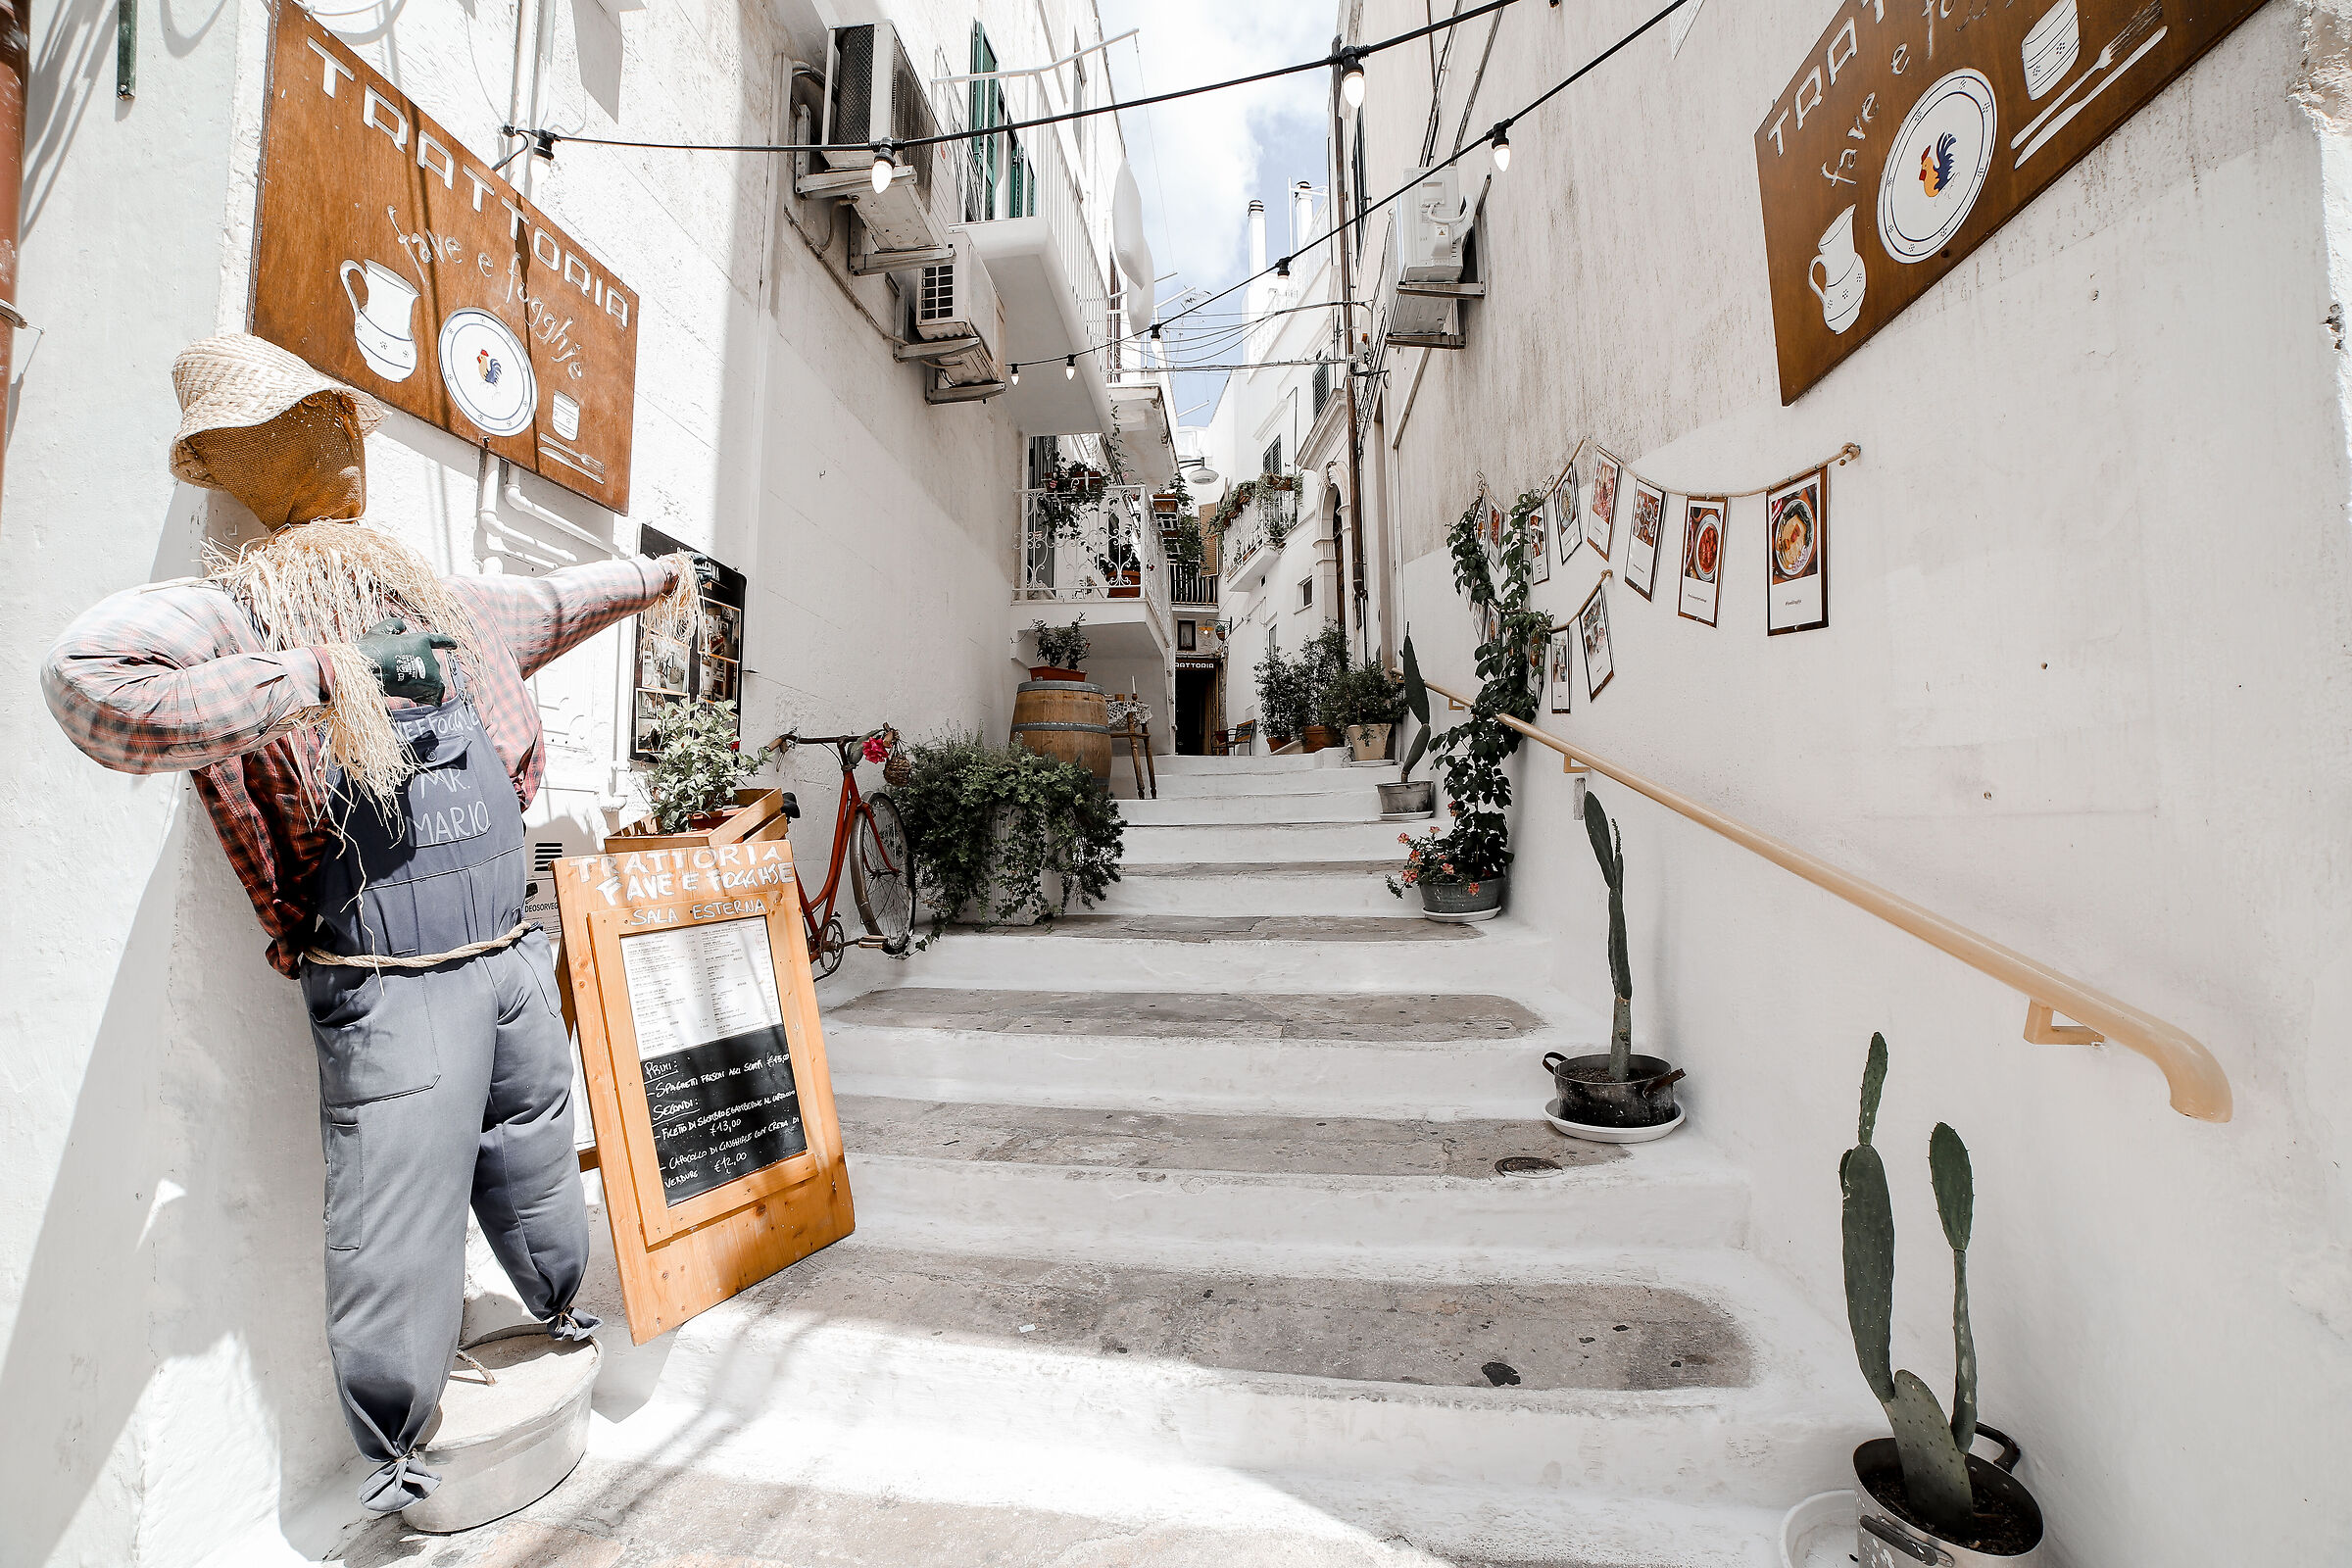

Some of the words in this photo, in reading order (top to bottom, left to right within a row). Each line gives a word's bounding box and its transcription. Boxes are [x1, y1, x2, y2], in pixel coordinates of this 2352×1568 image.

[1821, 92, 1880, 187] fave
[1890, 43, 1911, 75] e
[307, 36, 628, 328] TRATTORIA
[387, 205, 463, 284] fave
[477, 252, 494, 278] e
[406, 801, 489, 847] MARIO
[569, 845, 782, 883] TRATTORIA
[596, 872, 674, 906] FAVE
[681, 871, 699, 891] E
[630, 907, 679, 926] SALA
[692, 899, 766, 920] ESTERNA
[653, 1099, 699, 1120] SECONDI:
[662, 1123, 687, 1140] FILETTO
[688, 1120, 697, 1131] DI
[709, 1119, 742, 1137] €13,00
[709, 1146, 718, 1155] DI
[663, 1170, 699, 1188] VERDURE
